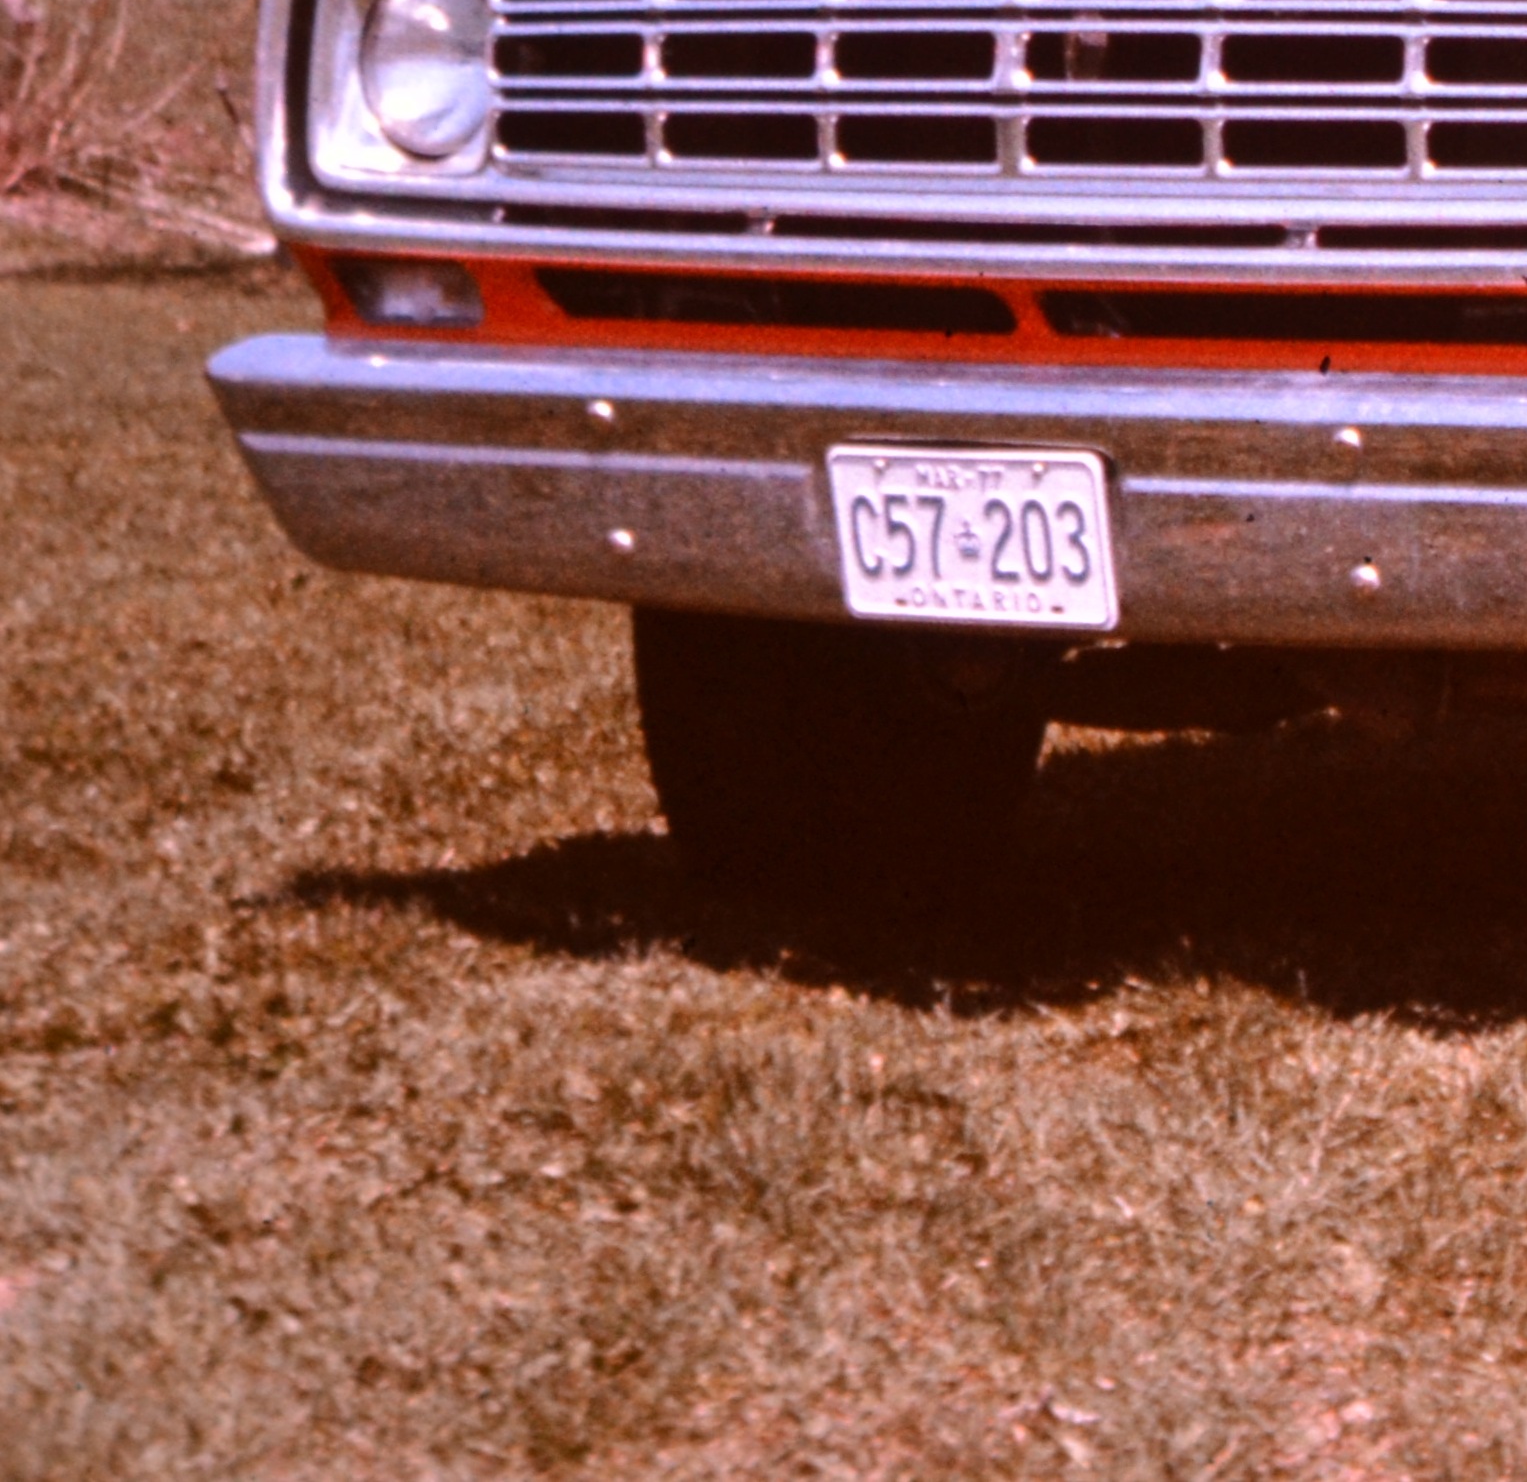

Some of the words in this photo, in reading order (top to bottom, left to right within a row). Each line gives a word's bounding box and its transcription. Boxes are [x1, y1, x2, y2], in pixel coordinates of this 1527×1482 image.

[851, 494, 945, 579] C57
[984, 498, 1091, 587] 203
[911, 586, 1041, 614] ONTARIO
